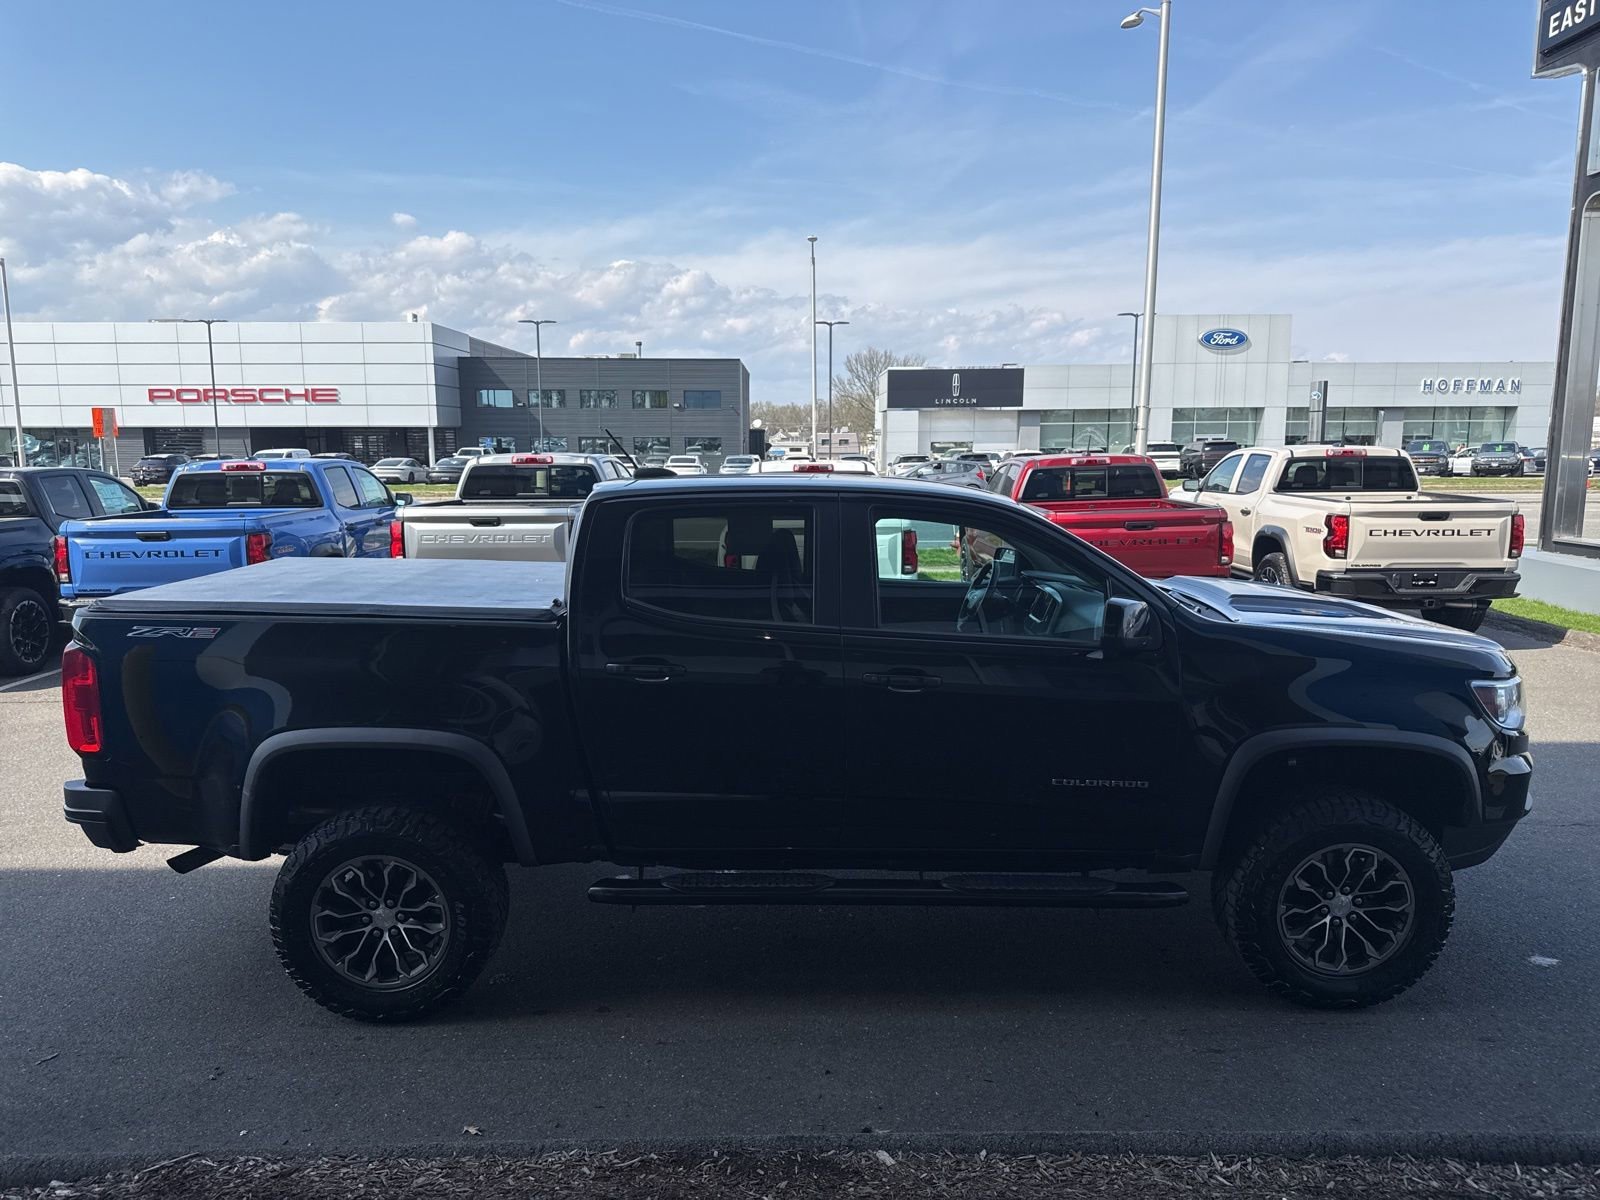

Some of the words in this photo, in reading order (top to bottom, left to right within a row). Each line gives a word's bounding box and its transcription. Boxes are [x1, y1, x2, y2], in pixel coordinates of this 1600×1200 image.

[1210, 332, 1239, 345] Ford
[1421, 378, 1521, 392] HOFFMAN
[148, 388, 339, 404] PORSCHE
[1368, 527, 1497, 537] CHEVROLET
[420, 534, 552, 544] CHEVROLET
[84, 549, 224, 559] CHEVROLET
[126, 625, 221, 639] ZR2
[1051, 778, 1149, 788] COLORADO
